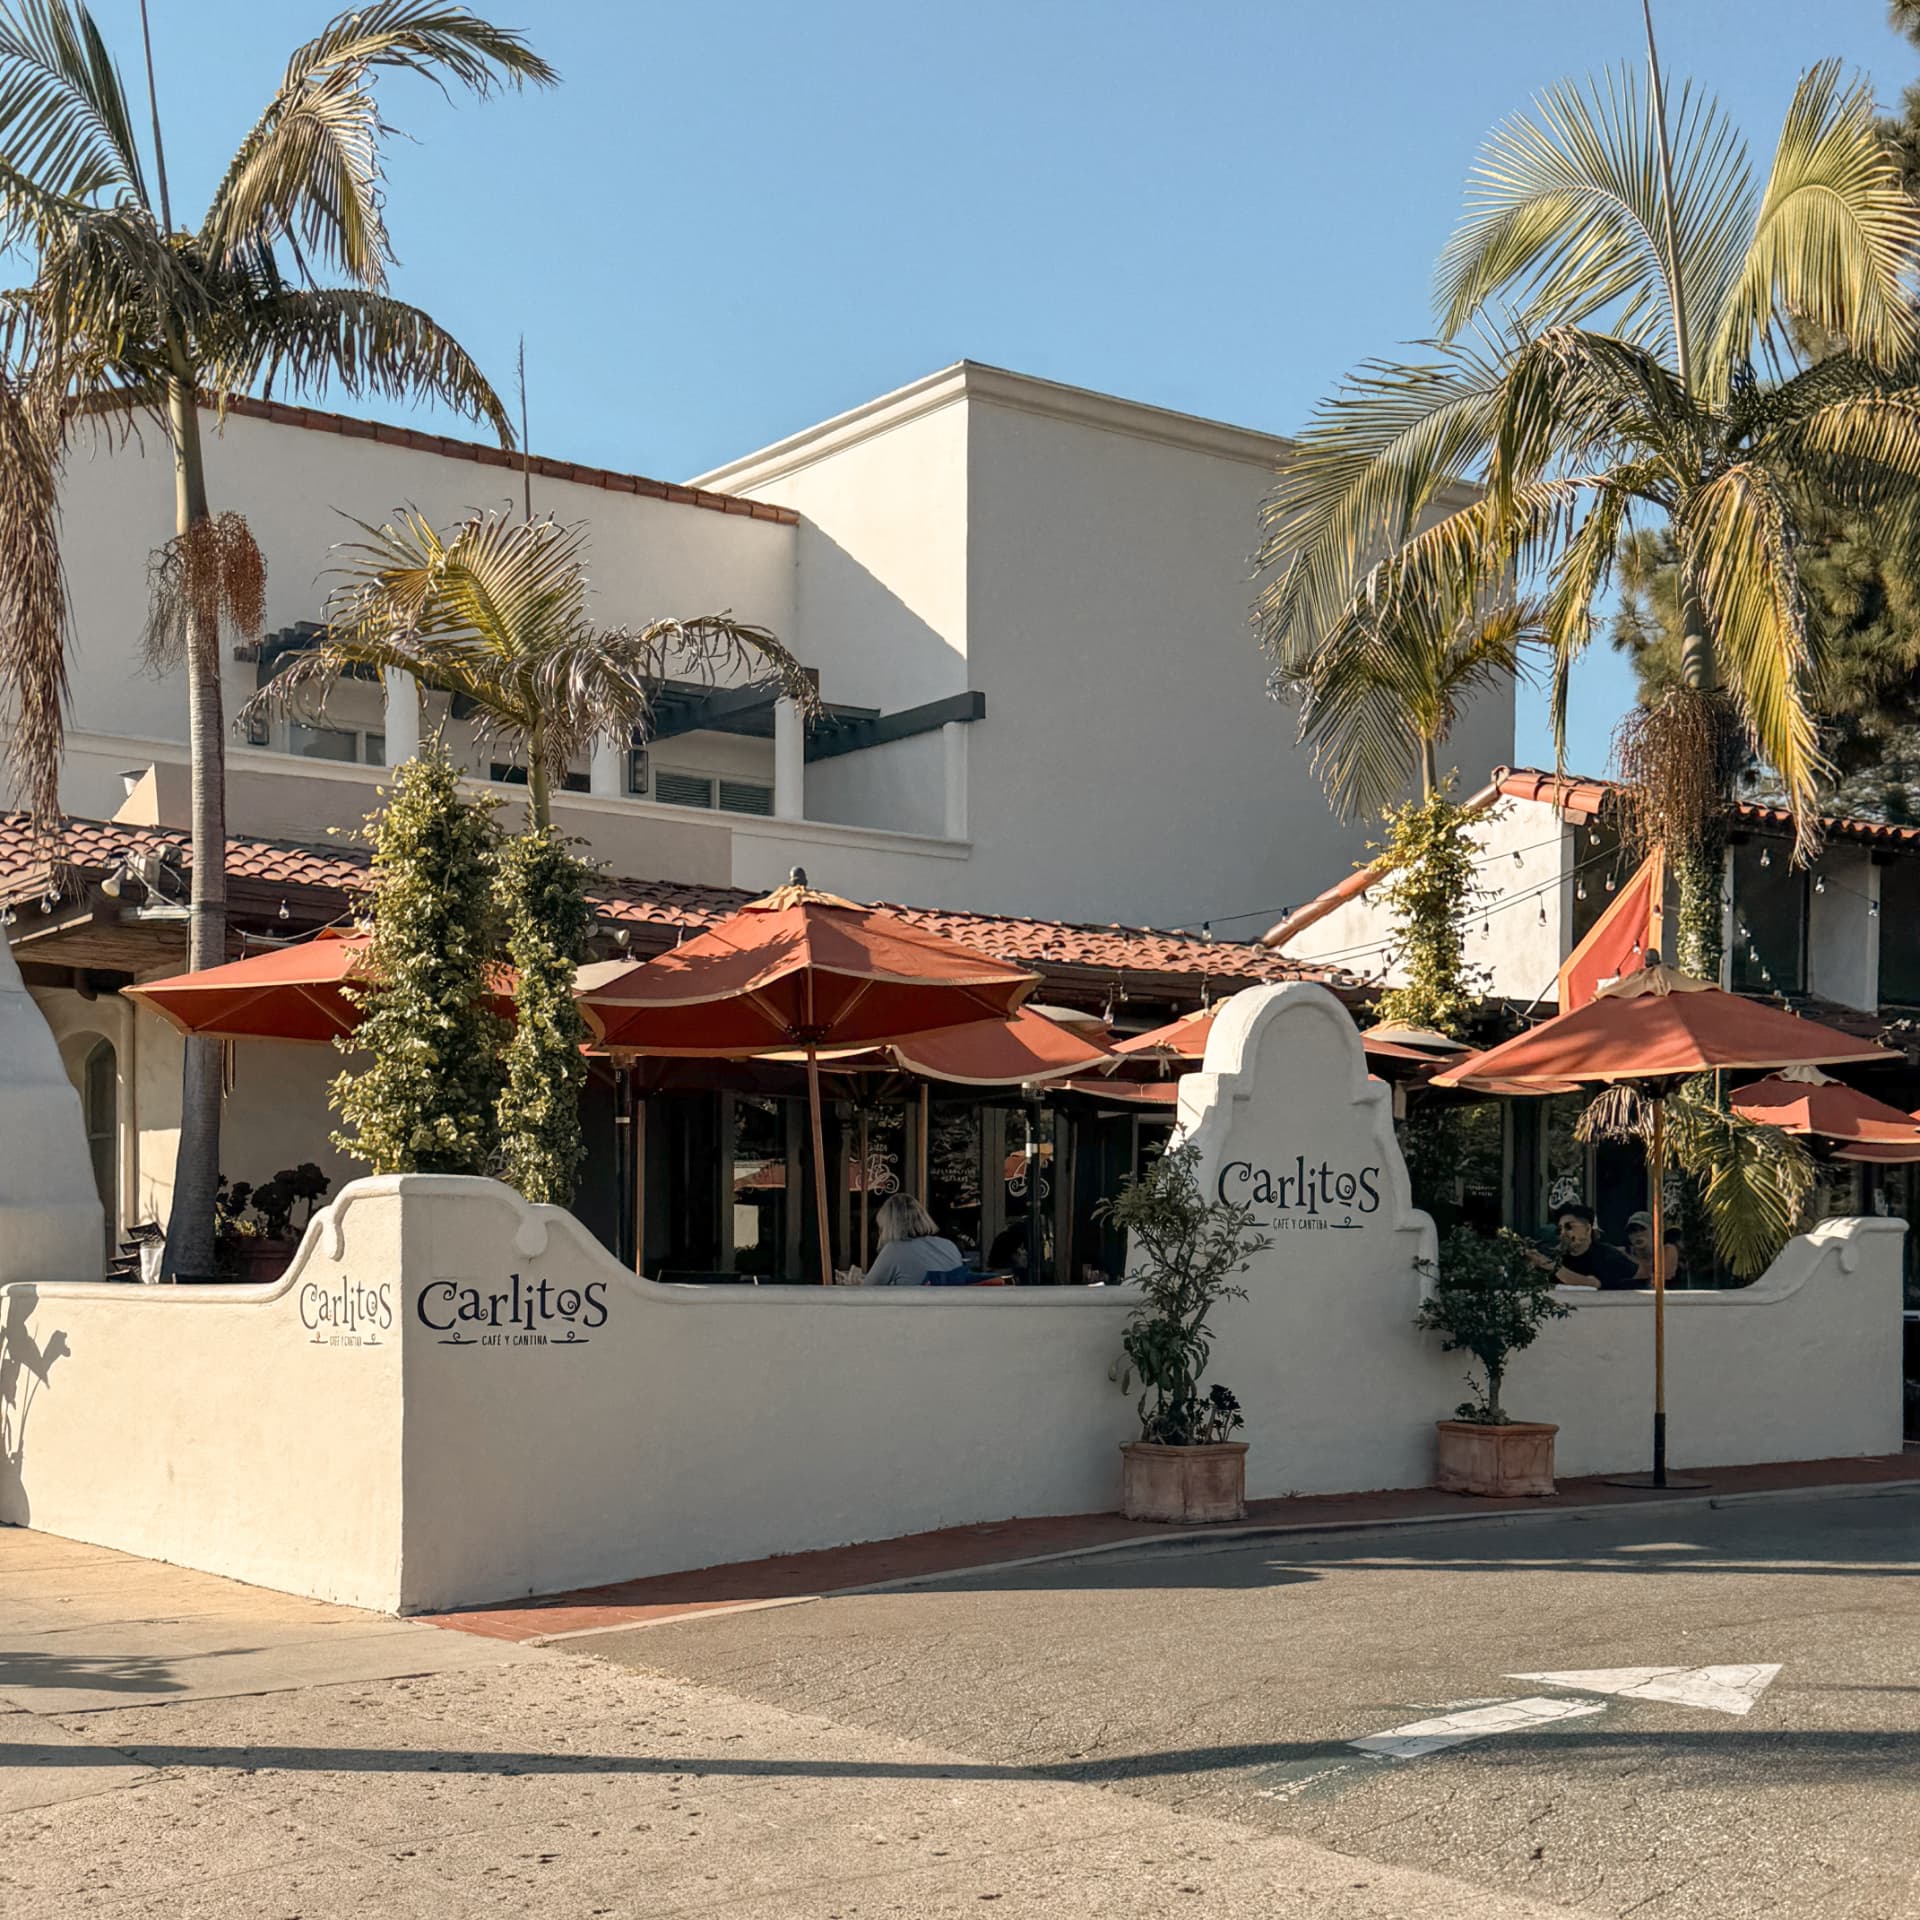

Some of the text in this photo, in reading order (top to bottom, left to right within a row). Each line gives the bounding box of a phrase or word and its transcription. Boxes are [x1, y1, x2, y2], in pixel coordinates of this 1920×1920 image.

[1218, 1155, 1380, 1214] Carlitos
[300, 1275, 392, 1331] Carlitos
[417, 1273, 608, 1330] Carlitos
[481, 1333, 548, 1346] CAFÉ Y CANTINA
